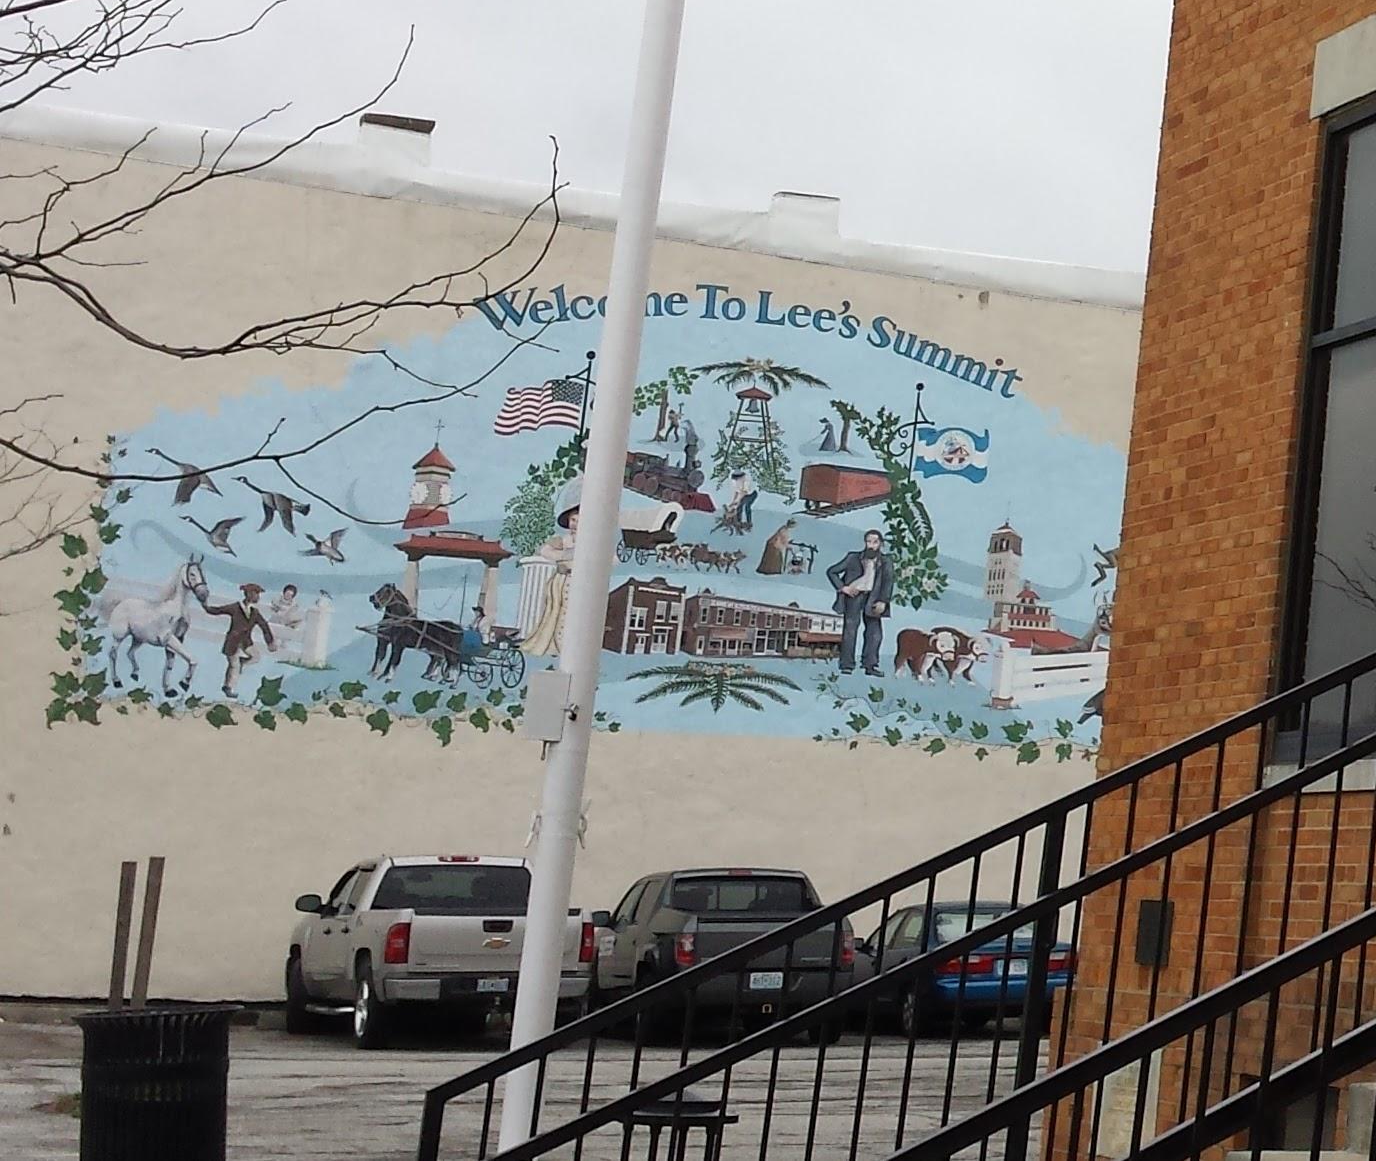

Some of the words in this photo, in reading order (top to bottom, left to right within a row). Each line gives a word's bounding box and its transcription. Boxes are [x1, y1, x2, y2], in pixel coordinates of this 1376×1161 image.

[695, 283, 747, 321] To
[755, 290, 861, 340] Lee's
[867, 315, 1024, 399] Summit
